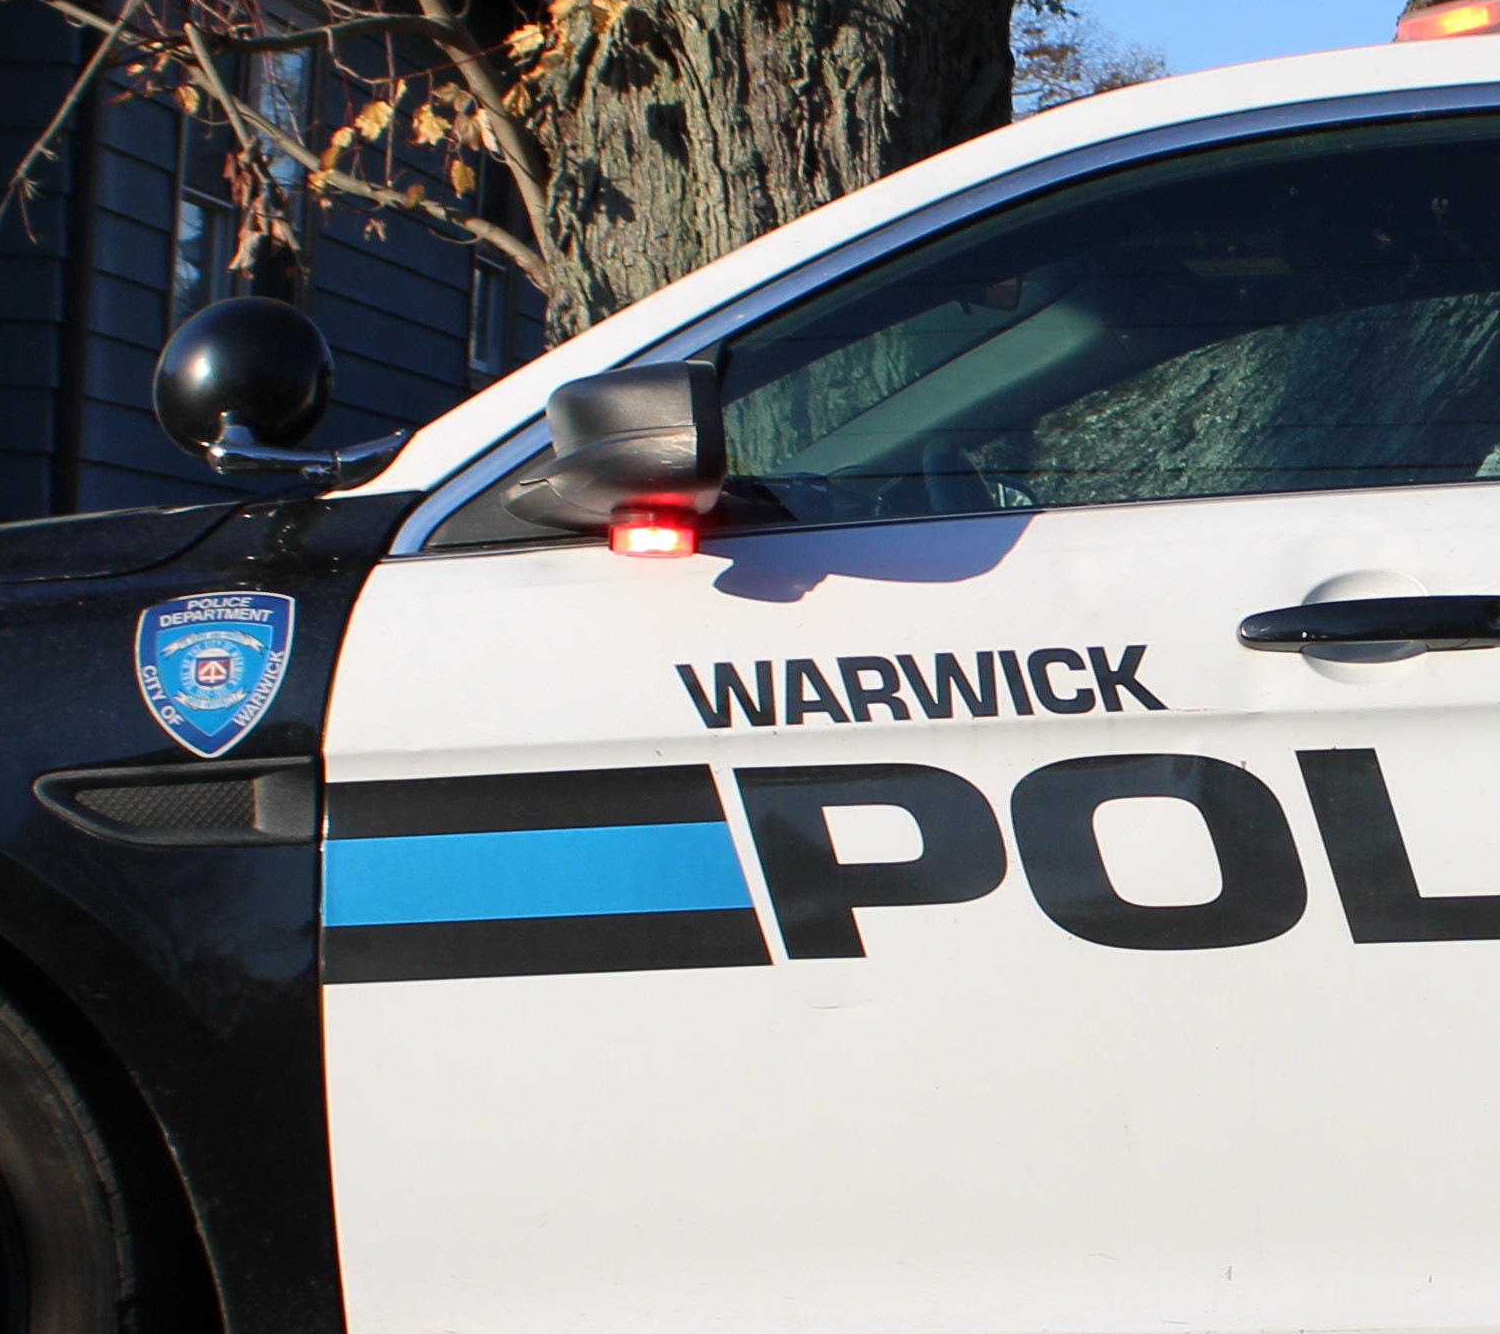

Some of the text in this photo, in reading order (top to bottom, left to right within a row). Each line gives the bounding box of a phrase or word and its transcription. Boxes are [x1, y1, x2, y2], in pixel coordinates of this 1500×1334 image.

[159, 609, 274, 627] DEPARTMENT
[187, 597, 253, 610] POLICE
[141, 665, 167, 702] CITY
[160, 705, 185, 727] OF
[232, 651, 285, 728] WARWICK
[673, 644, 1169, 729] WARWICK
